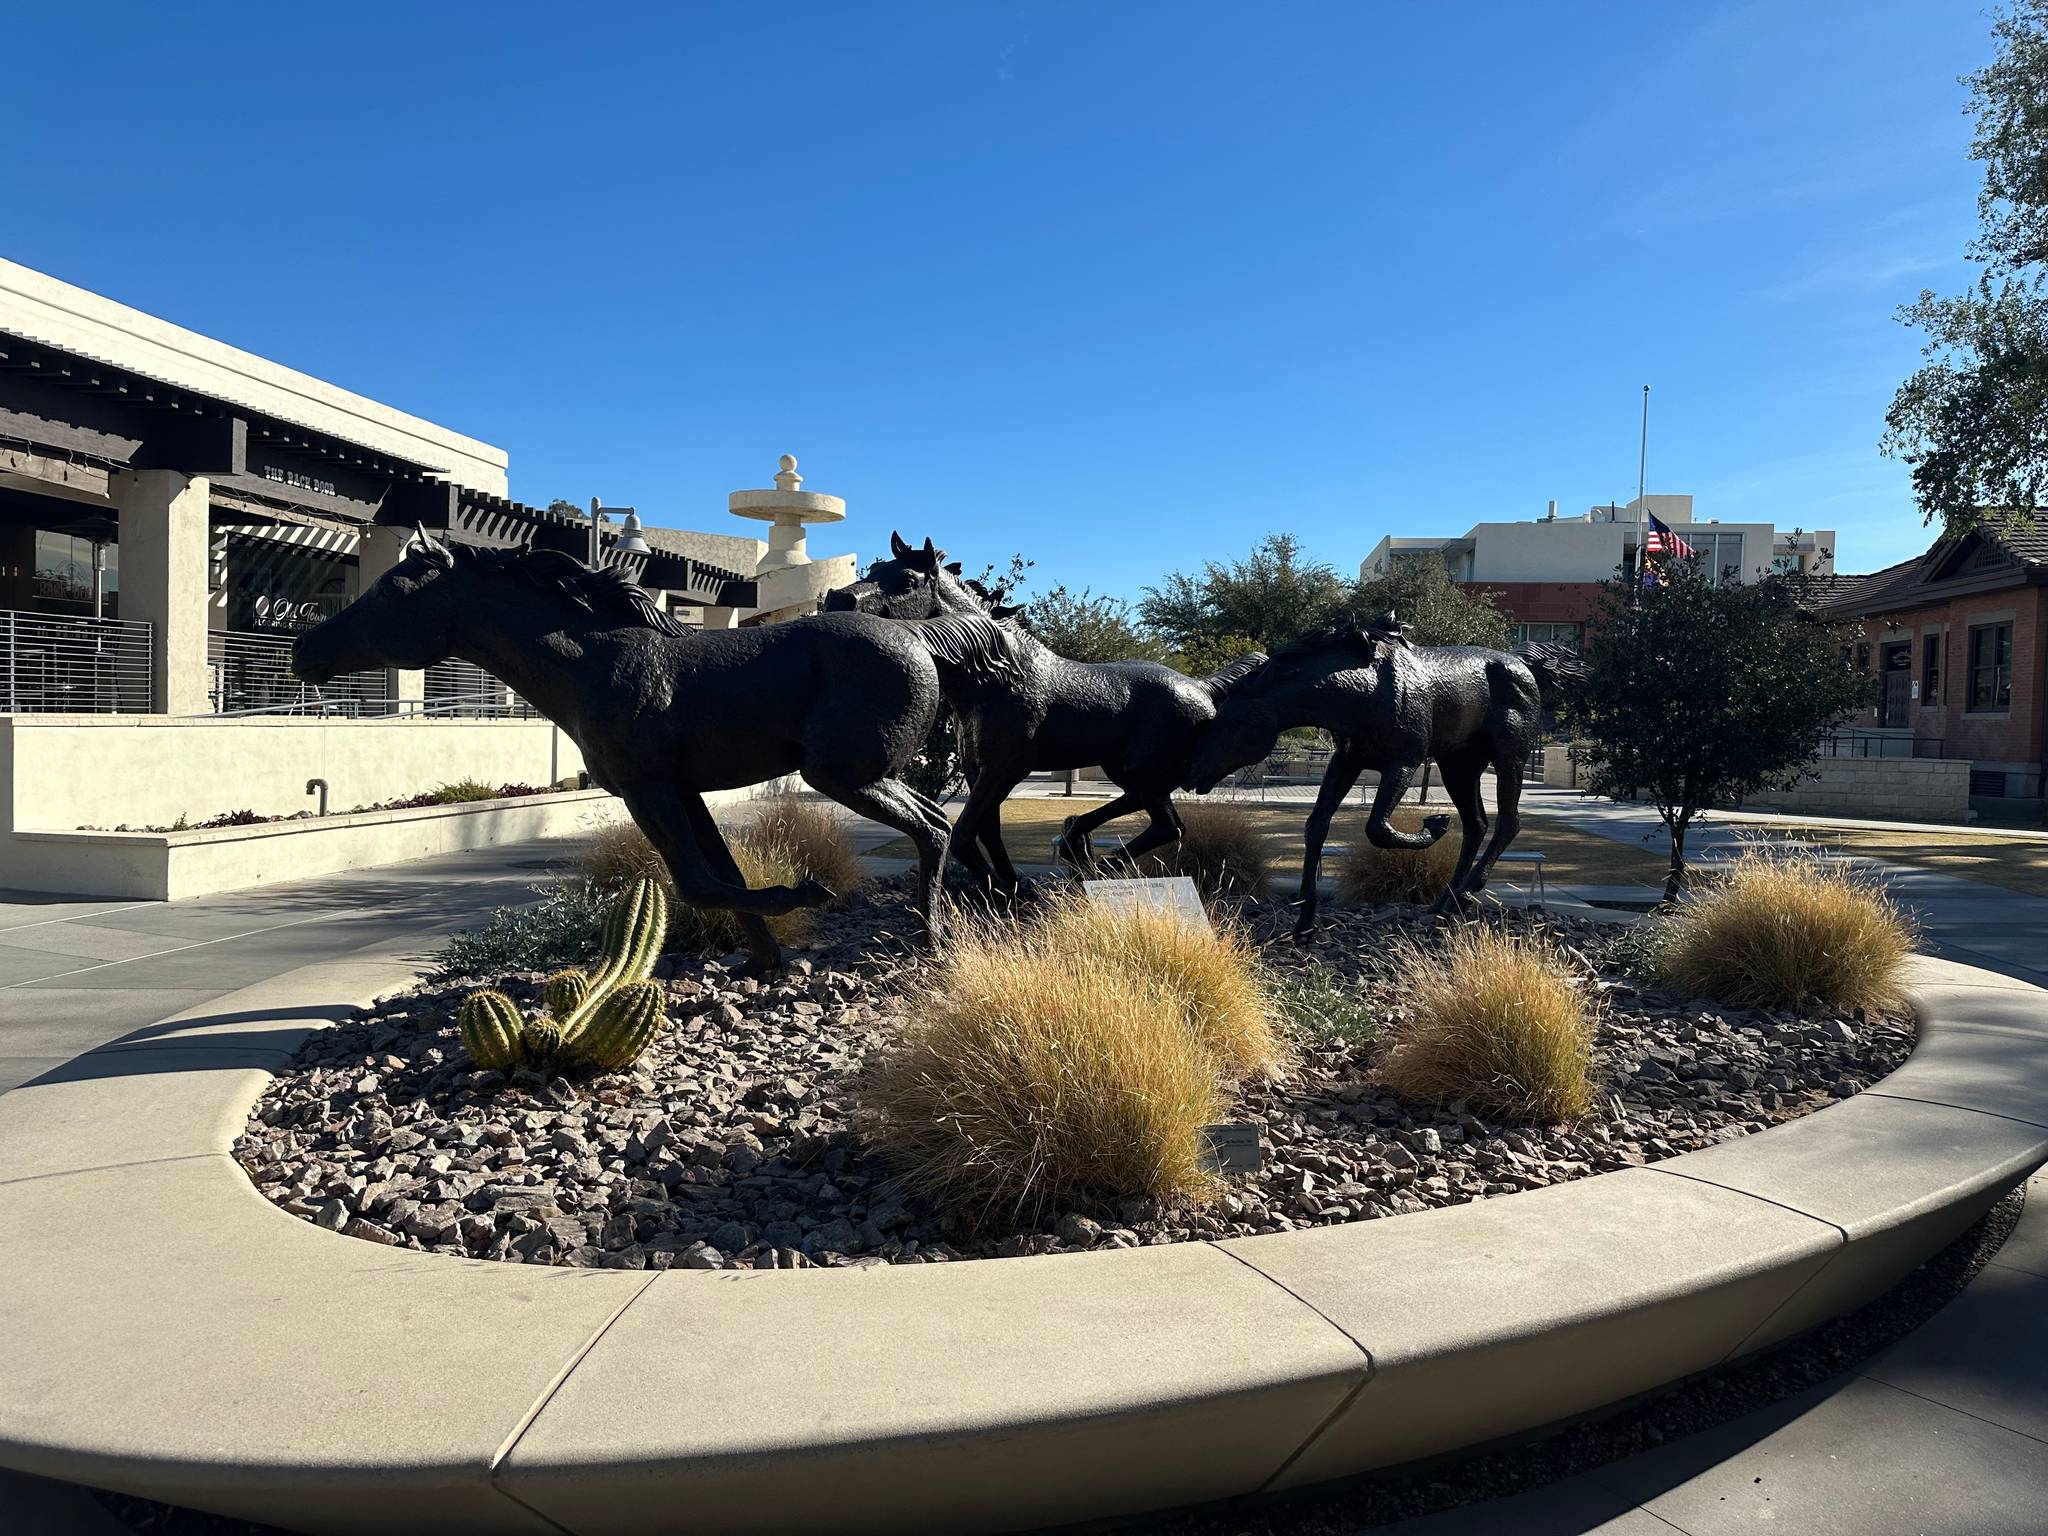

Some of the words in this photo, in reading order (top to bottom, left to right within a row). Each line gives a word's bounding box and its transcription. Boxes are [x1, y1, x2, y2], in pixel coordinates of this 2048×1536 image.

[264, 465, 284, 482] THE
[287, 471, 311, 490] BACK
[314, 478, 336, 496] DOOR
[273, 597, 299, 621] Old
[300, 602, 328, 623] Town
[254, 619, 287, 629] FLOORING
[288, 622, 317, 631] SCOTTS
